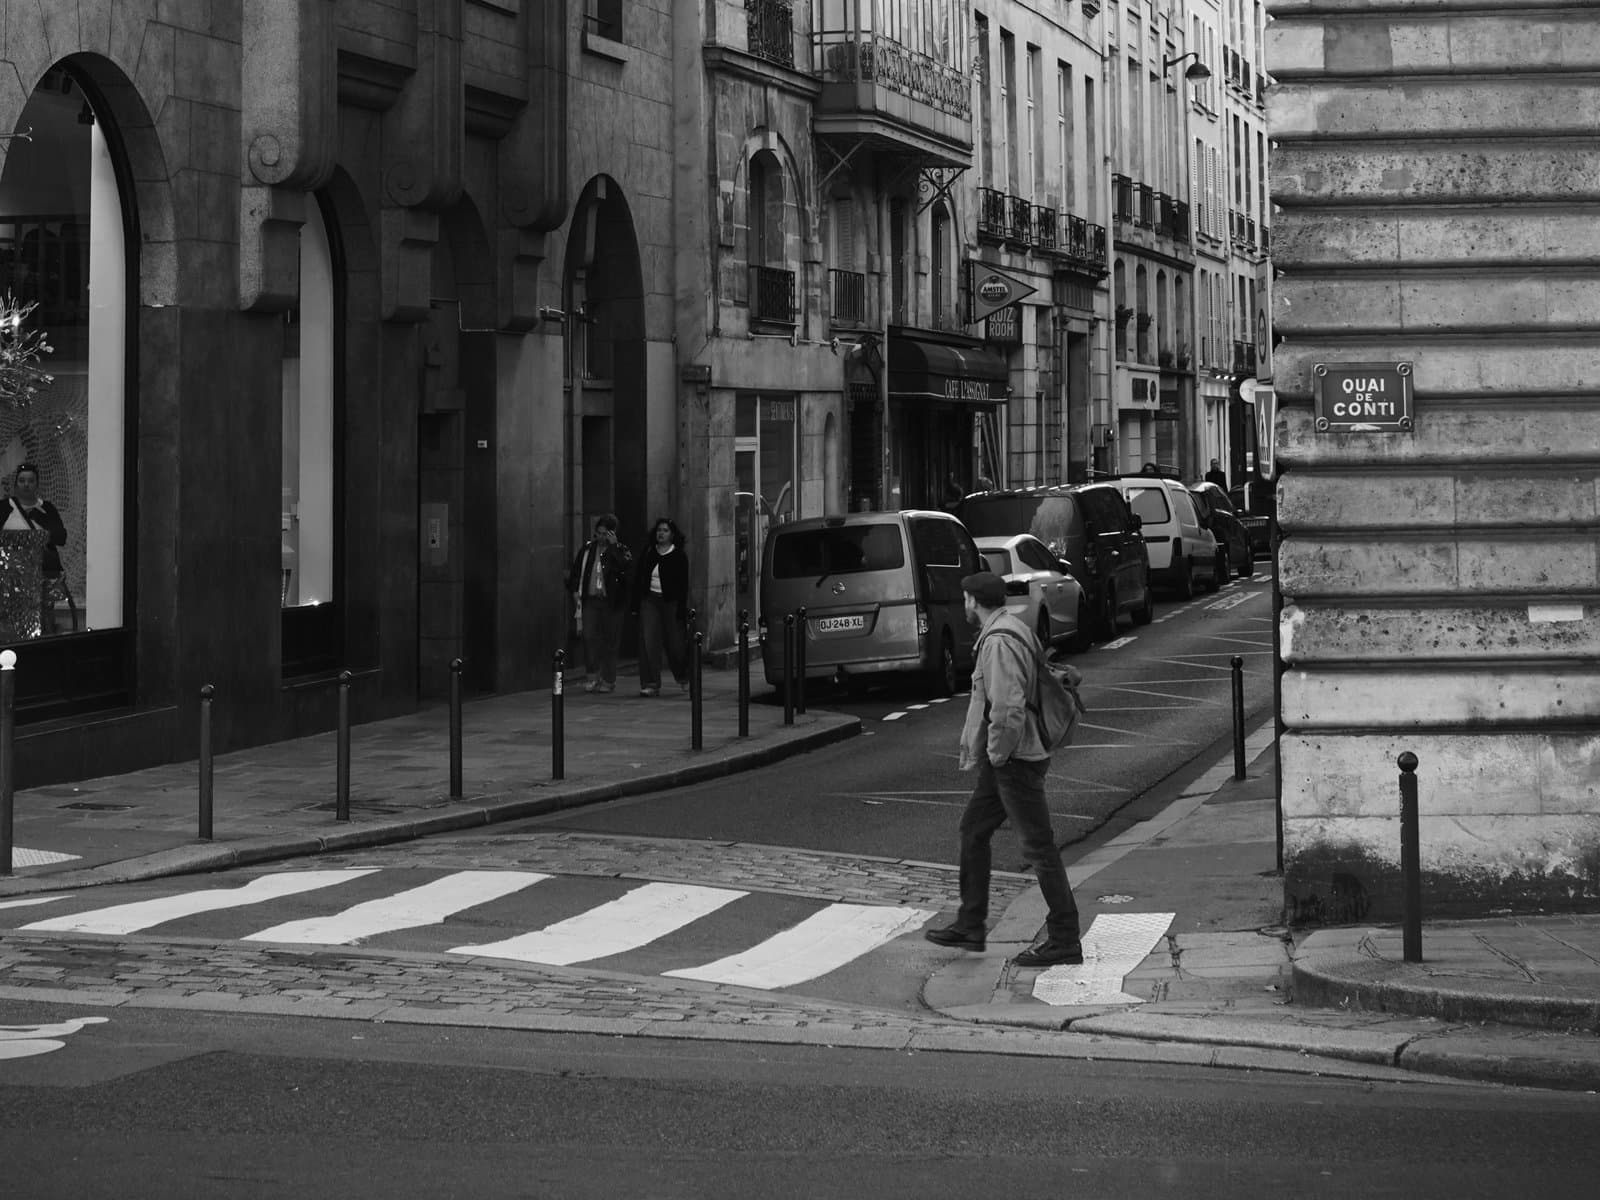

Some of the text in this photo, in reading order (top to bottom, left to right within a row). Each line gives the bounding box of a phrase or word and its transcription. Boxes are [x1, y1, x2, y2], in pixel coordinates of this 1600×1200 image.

[989, 323, 1013, 337] ROOM
[1342, 378, 1385, 393] QUAI
[1355, 393, 1373, 402] DE
[1333, 402, 1395, 416] CONTI
